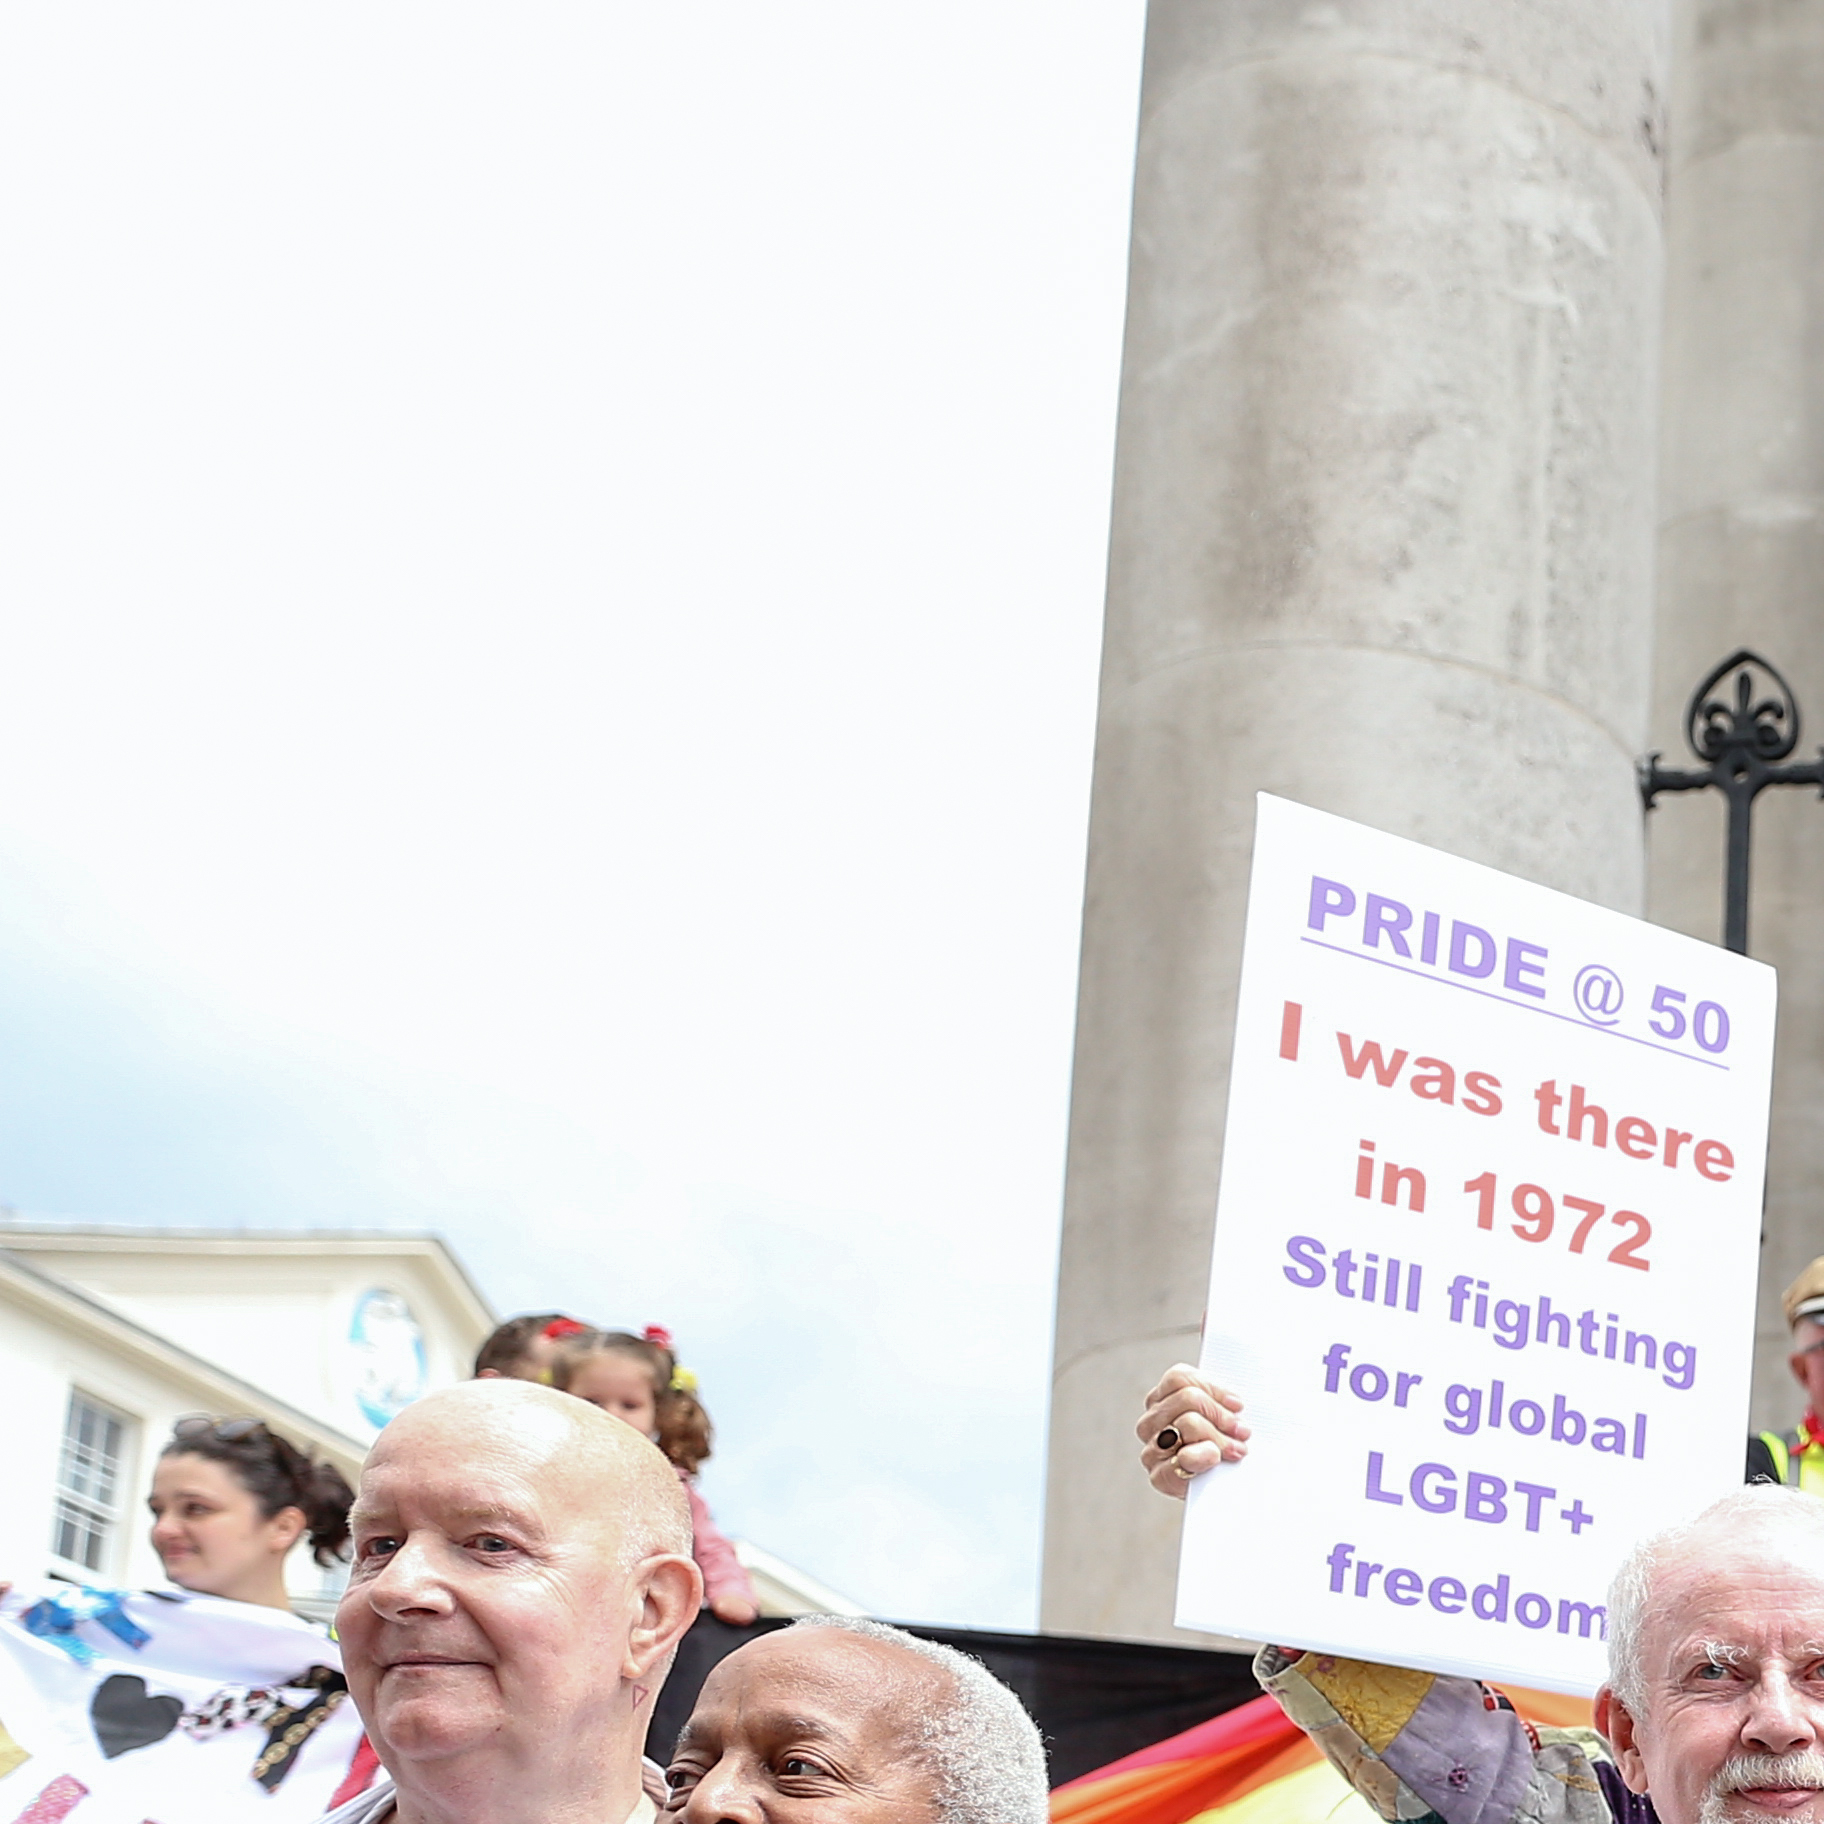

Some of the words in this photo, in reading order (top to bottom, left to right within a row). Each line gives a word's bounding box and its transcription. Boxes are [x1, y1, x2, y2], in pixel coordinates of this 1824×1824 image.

[1302, 877, 1548, 998] PRIDE
[1574, 965, 1622, 1026] @
[1650, 986, 1729, 1052] 50
[1280, 1002, 1302, 1061] I
[1338, 1032, 1502, 1115] was
[1536, 1080, 1734, 1181] there
[1356, 1140, 1426, 1212] in
[1466, 1173, 1651, 1271] 1972
[1284, 1236, 1421, 1312] Still
[1448, 1276, 1696, 1389] fighting
[1324, 1344, 1422, 1407] for
[1446, 1380, 1646, 1459] global
[1368, 1452, 1592, 1534] LGBT+
[1328, 1544, 1608, 1641] freedom
